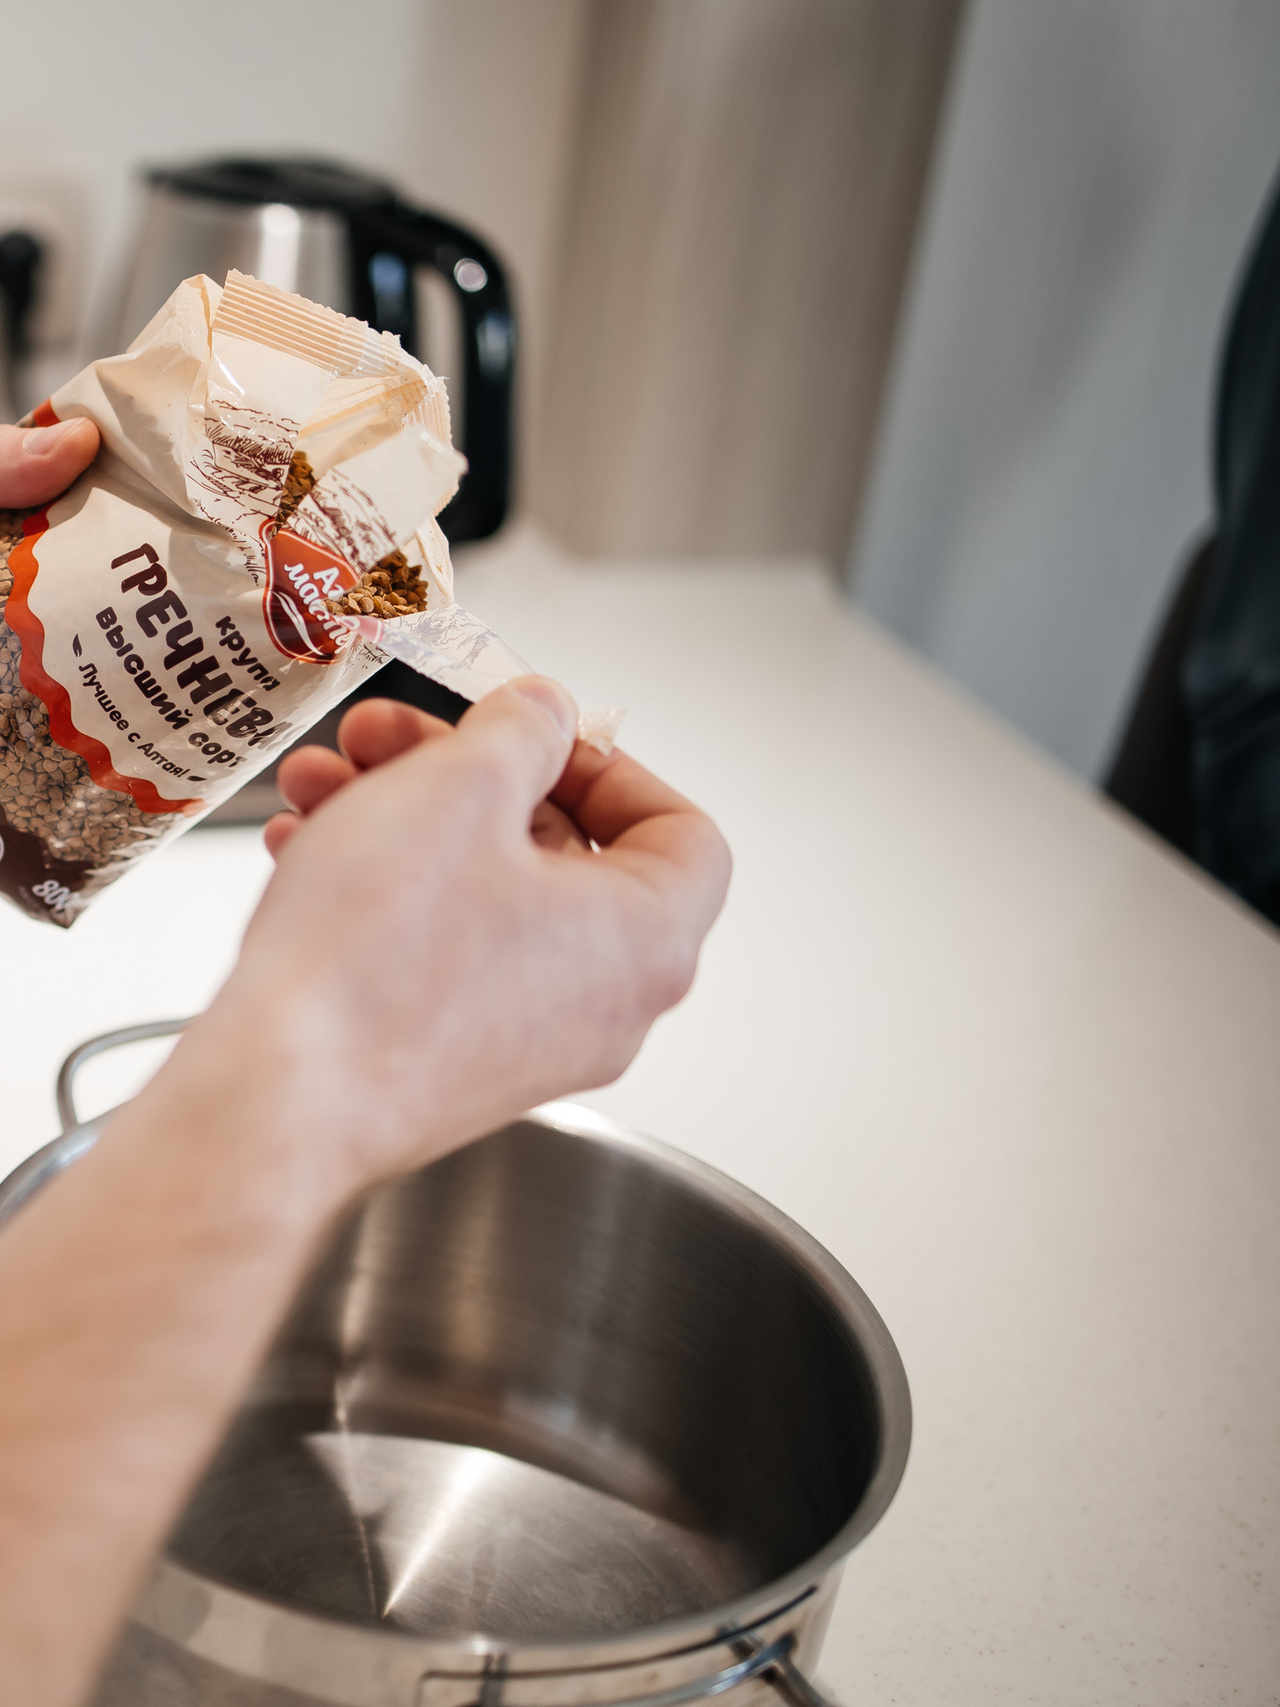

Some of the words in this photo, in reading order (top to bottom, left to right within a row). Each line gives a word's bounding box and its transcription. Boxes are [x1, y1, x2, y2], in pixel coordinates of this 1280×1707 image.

[215, 615, 281, 692] крупа
[78, 662, 130, 731] Лучшее
[127, 731, 141, 743] с
[136, 742, 191, 779] Алтая!
[188, 731, 248, 768] сорт
